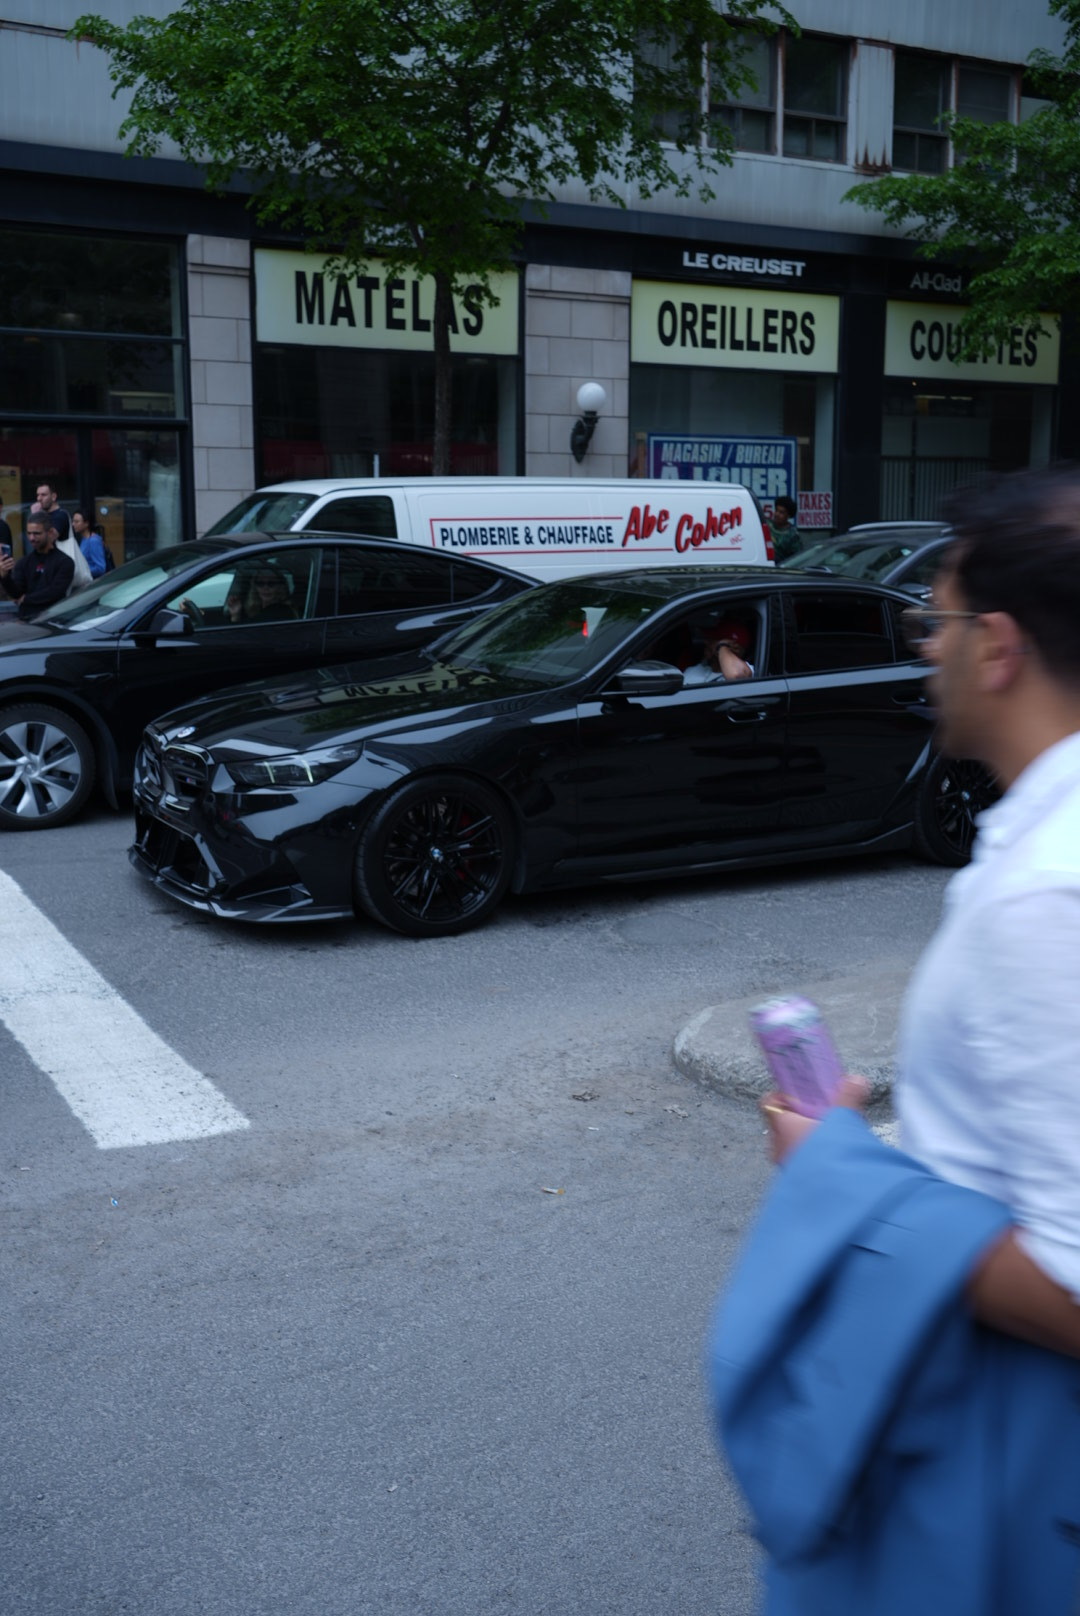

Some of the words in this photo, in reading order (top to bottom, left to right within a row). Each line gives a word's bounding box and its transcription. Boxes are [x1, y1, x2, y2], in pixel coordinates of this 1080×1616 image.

[682, 250, 710, 270] LE
[711, 253, 806, 278] CREUSET
[657, 300, 815, 356] OREILLERS
[661, 442, 723, 463] MAGASIN
[735, 445, 786, 465] BUREAU
[798, 493, 831, 511] TAXES
[440, 526, 520, 547] PLOMBERIE
[524, 526, 534, 546] &
[537, 526, 614, 545] CHAUFFAGE
[621, 504, 669, 547] Abe
[675, 506, 742, 553] Cohen
